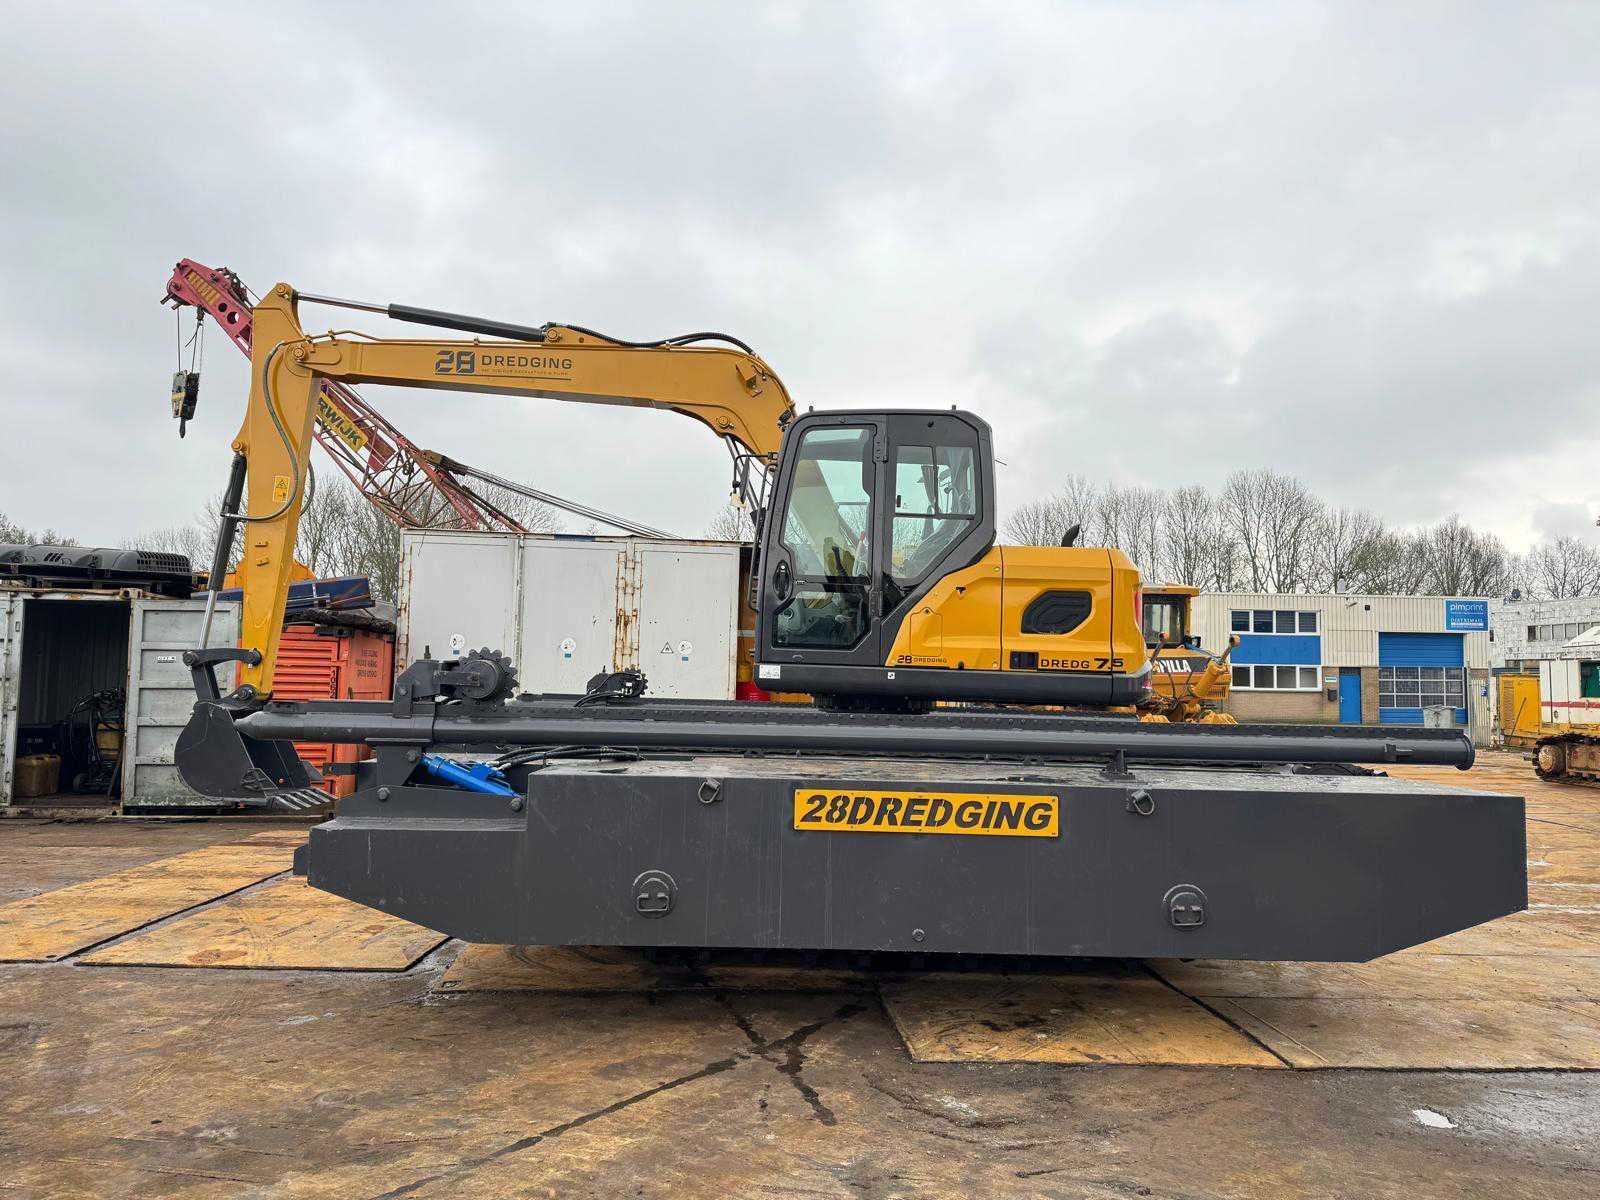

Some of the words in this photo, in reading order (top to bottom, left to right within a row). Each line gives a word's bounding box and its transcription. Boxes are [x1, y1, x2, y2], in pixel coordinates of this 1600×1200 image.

[434, 350, 475, 374] 28
[481, 355, 572, 370] DREDGING
[1040, 658, 1090, 669] DREDG
[1094, 657, 1124, 670] 7.5
[800, 794, 1053, 831] 28DREDGING
